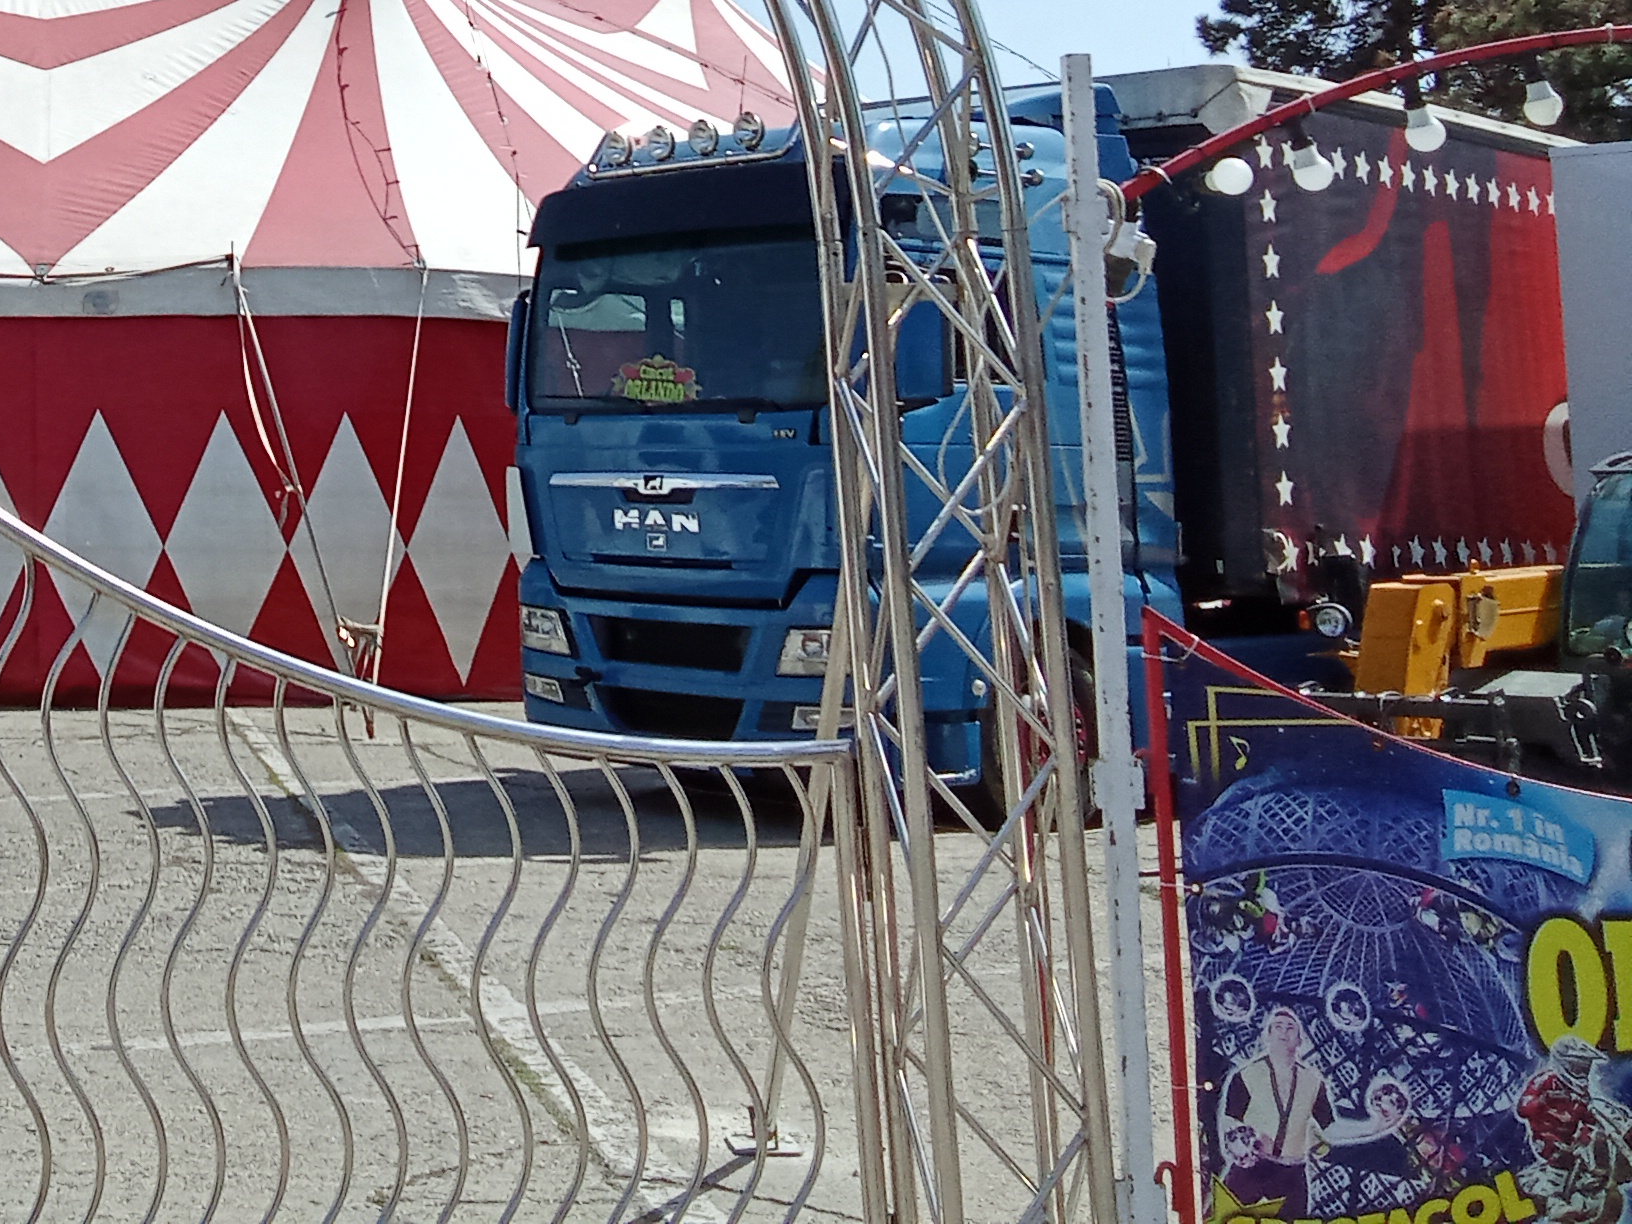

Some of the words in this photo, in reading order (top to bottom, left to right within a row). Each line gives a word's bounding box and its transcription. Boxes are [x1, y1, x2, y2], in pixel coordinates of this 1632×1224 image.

[624, 379, 685, 403] ORLANDO
[613, 508, 700, 533] MAN
[1453, 803, 1500, 828] Nr.
[1507, 807, 1524, 832] 1
